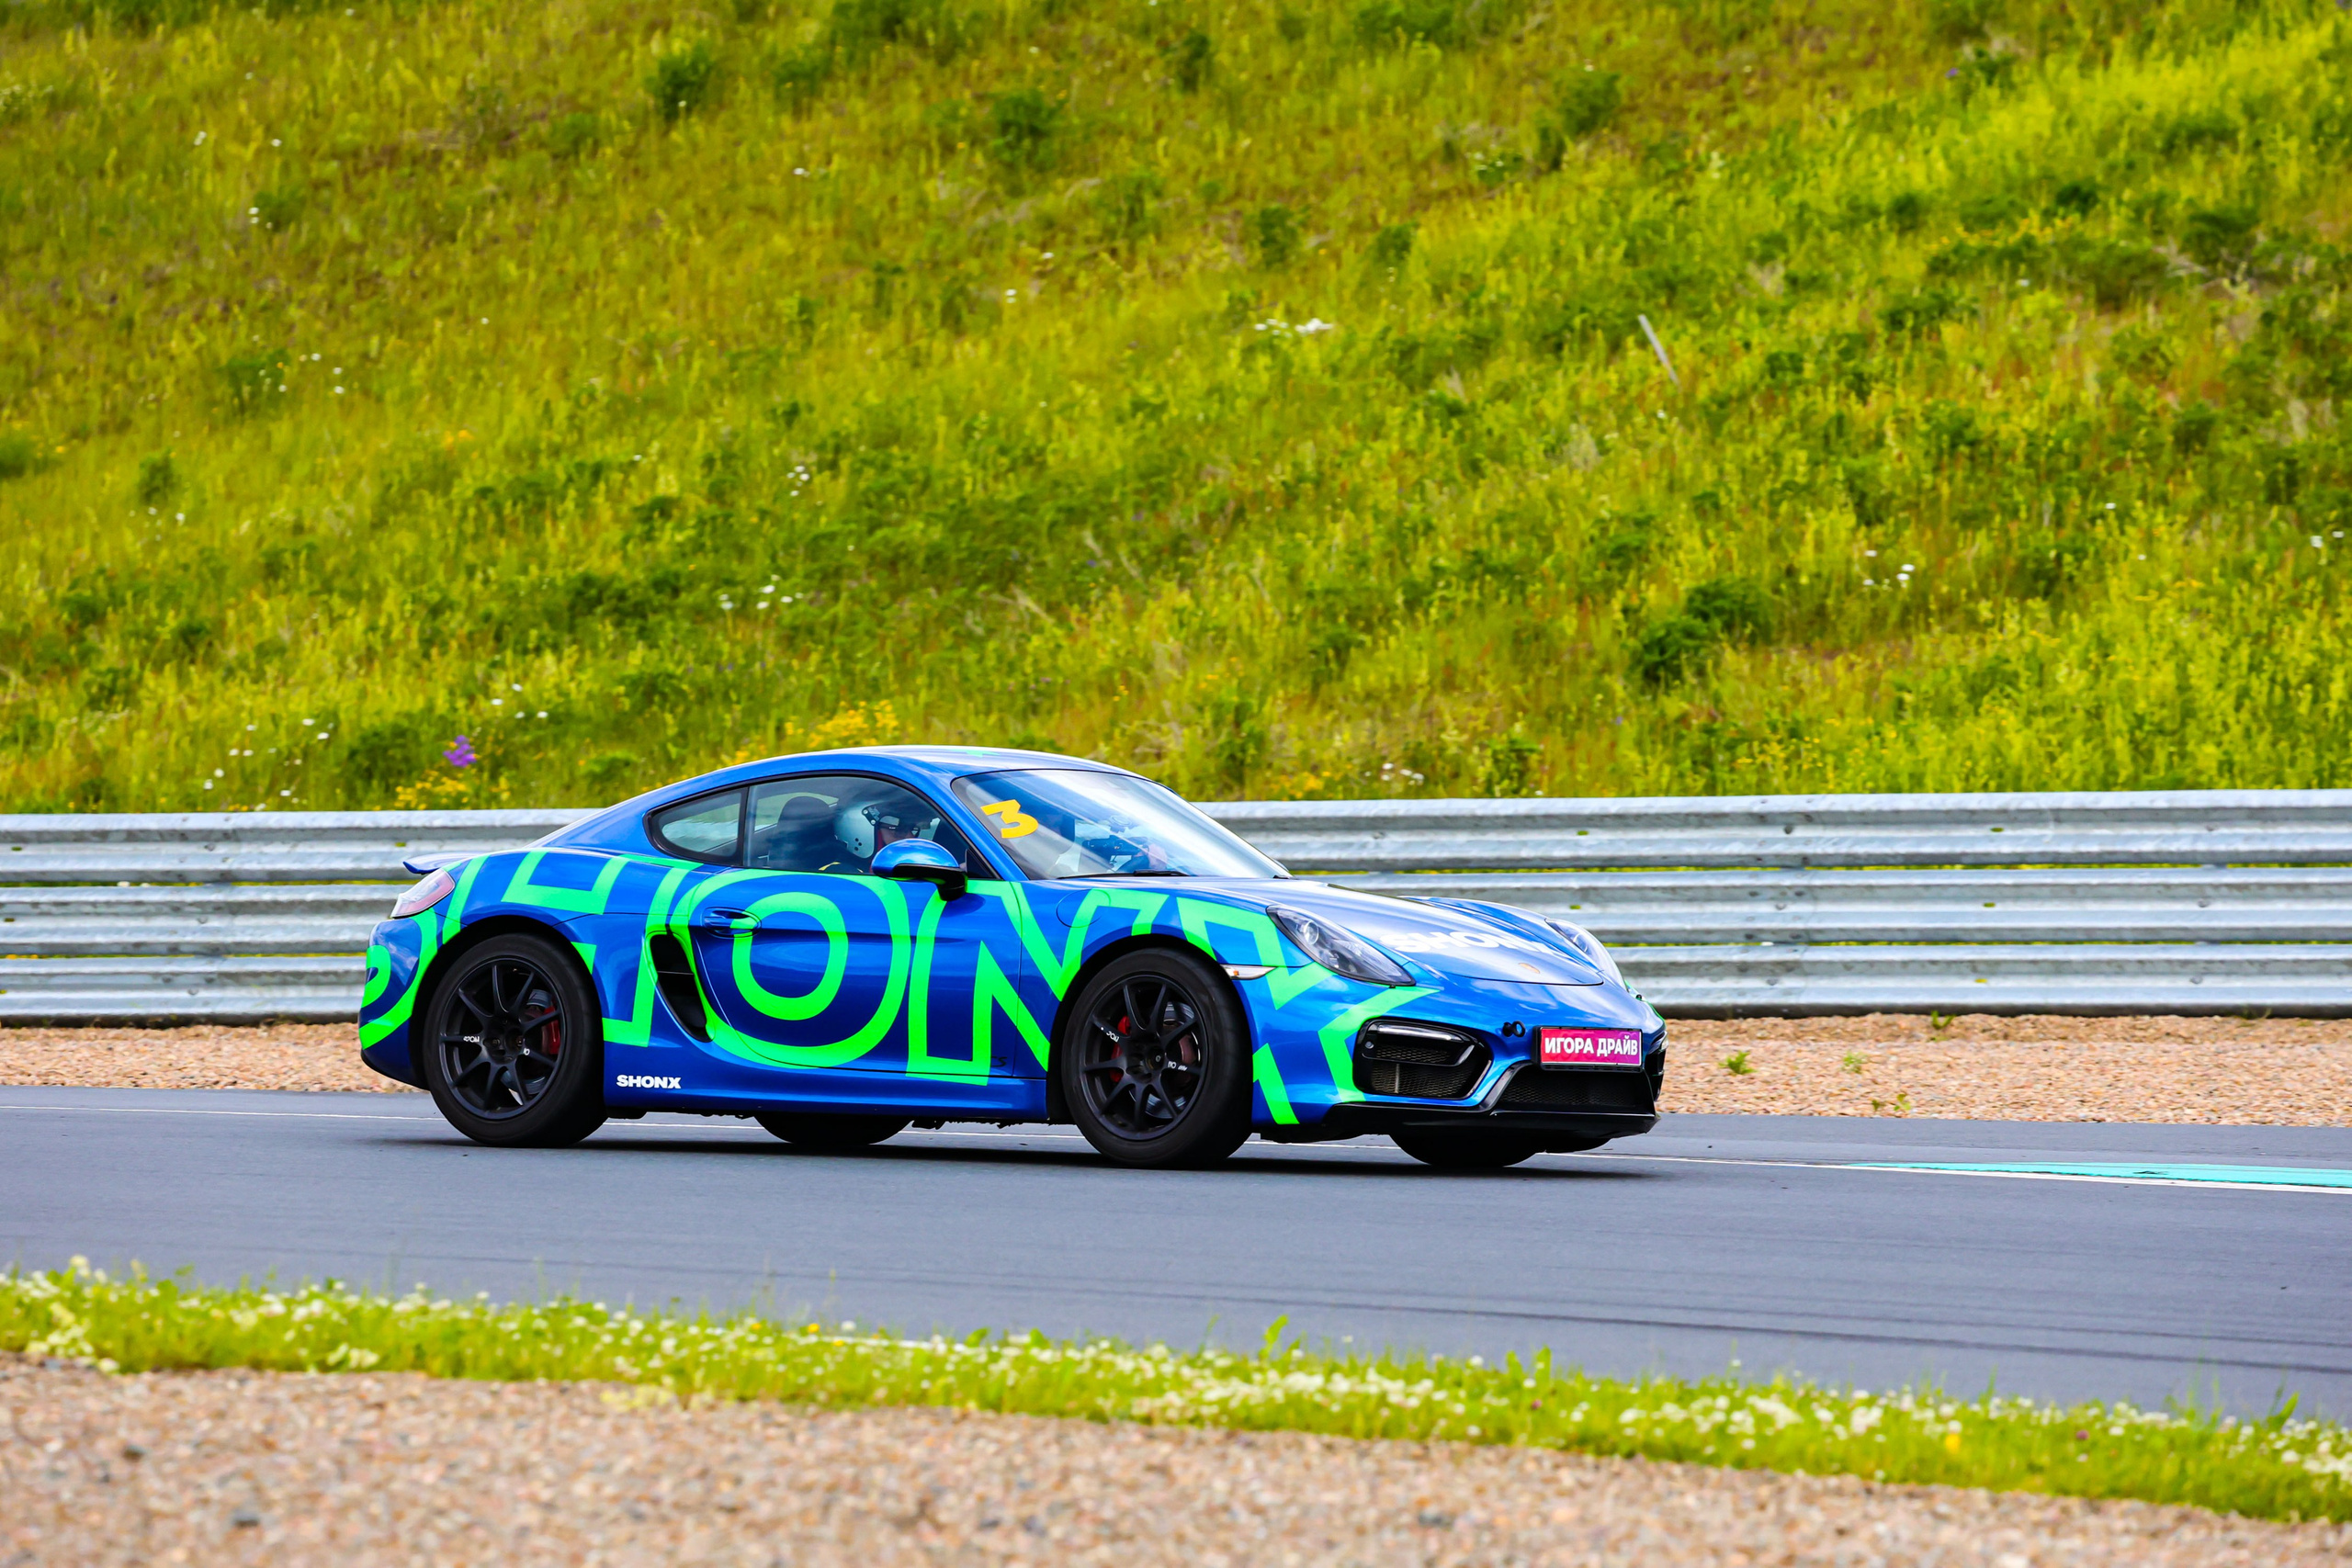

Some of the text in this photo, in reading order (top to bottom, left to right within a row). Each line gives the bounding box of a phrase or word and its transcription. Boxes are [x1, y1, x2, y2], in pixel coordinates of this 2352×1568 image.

[979, 798, 1039, 839] 3
[1544, 1035, 1638, 1057] ИГОРА ДРАЙВ
[616, 1074, 682, 1089] SHONX
